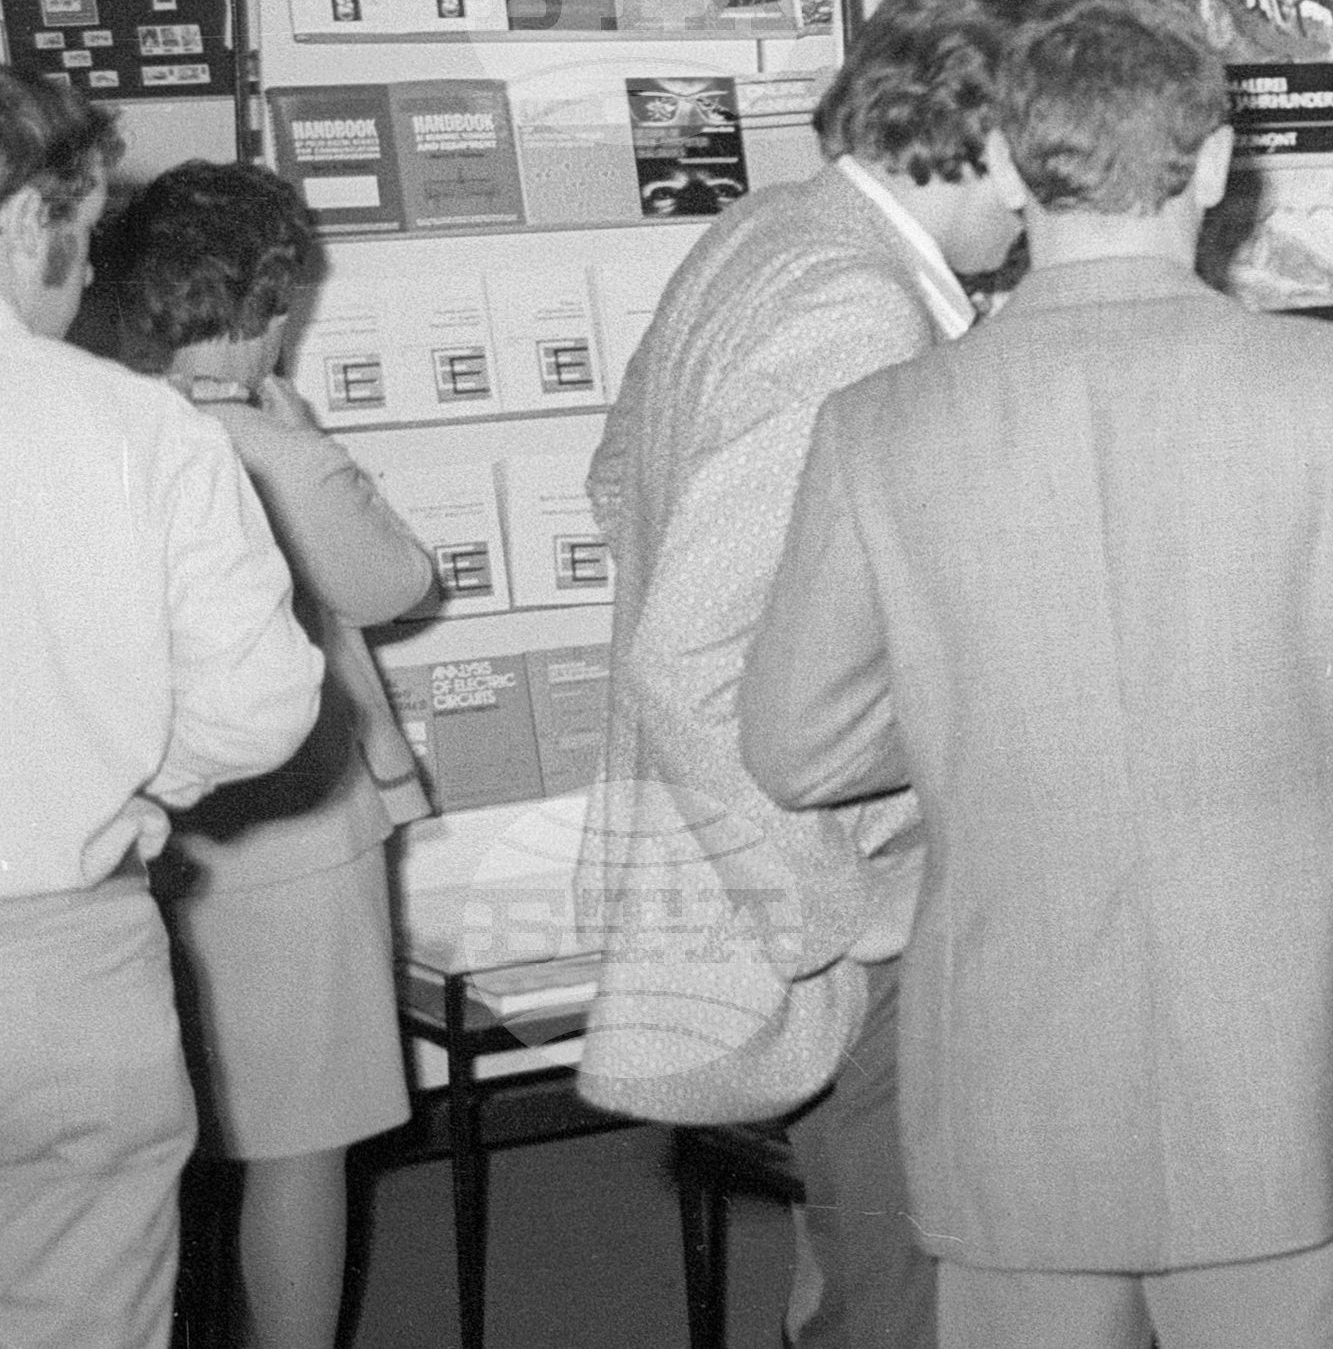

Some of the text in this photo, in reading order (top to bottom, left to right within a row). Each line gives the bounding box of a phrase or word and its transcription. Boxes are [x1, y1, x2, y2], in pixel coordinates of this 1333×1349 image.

[291, 118, 378, 141] HANDBOOK
[411, 112, 495, 135] HANDBOOK
[431, 660, 493, 680] ANALYSIS
[432, 672, 517, 696] OF ELECTRIC
[433, 689, 498, 710] CIRCUITS
